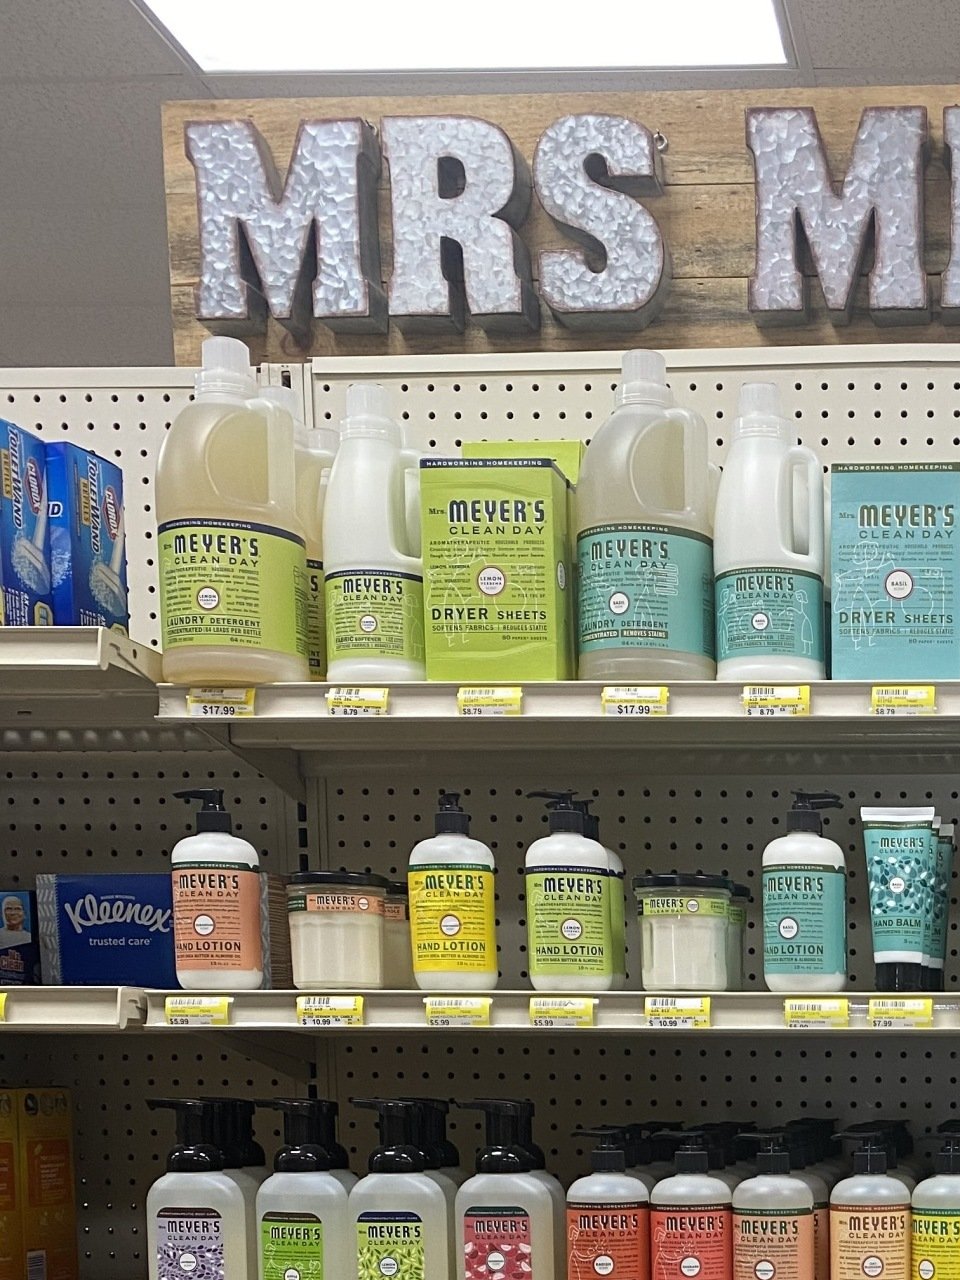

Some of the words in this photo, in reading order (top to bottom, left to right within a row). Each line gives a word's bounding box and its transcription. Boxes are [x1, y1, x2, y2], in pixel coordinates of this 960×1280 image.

[182, 112, 668, 319] MRS
[26, 462, 40, 513] CLOROX
[105, 489, 119, 538] CLOROX
[449, 500, 546, 523] MEYER'S
[859, 505, 955, 527] MEYER'S
[450, 526, 505, 535] CLEAN
[513, 525, 545, 535] DAY
[174, 534, 259, 556] MEYER'S
[591, 540, 669, 559] MEYER'S
[174, 557, 223, 565] CLEAN
[231, 557, 259, 566] DAY
[344, 578, 403, 595] MEYER'S
[166, 615, 205, 626] LAUNDRY
[210, 617, 260, 626] DETERGENT
[432, 608, 488, 620] DRYER
[498, 610, 546, 620] SHEETS
[840, 611, 895, 624] DRYER
[905, 614, 953, 624] SHEETS
[203, 706, 235, 715] $17.99
[617, 705, 650, 714] $17.99
[880, 837, 923, 848] MEYER'S
[180, 875, 239, 890] MEYER'S
[425, 875, 484, 890] MEYER'S
[768, 879, 824, 893] MEYER'S
[64, 893, 171, 934] Kleenex
[89, 936, 125, 947] trusted
[128, 938, 150, 946] care
[417, 942, 441, 951] HAND
[443, 942, 486, 951] LOTION
[167, 1221, 220, 1233] MEYER'S
[474, 1220, 528, 1233] MEYER'S
[579, 1215, 638, 1231] MEYER'S
[741, 1219, 799, 1235] MEYER'S
[849, 1215, 905, 1232] MEYER'S
[368, 1225, 421, 1238] MEYER'S
